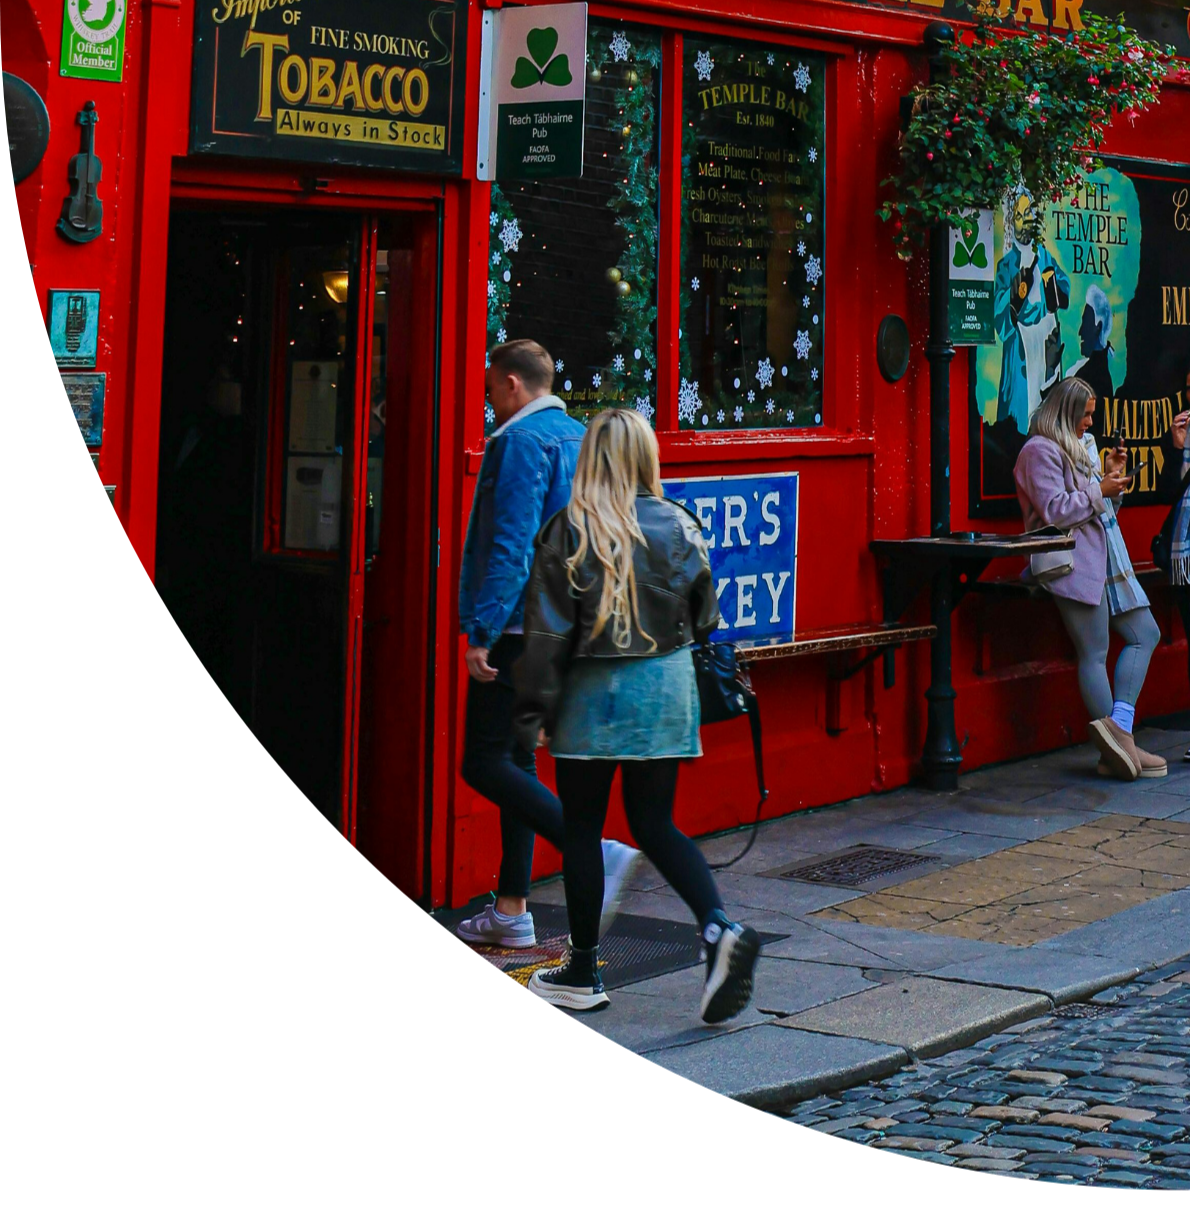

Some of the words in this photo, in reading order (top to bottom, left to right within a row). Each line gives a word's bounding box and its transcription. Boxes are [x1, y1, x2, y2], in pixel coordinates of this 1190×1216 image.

[281, 10, 302, 25] OF
[76, 41, 113, 56] Official
[310, 25, 350, 50] FINE
[353, 32, 430, 60] SMOKING
[72, 53, 115, 68] Member
[241, 29, 430, 122] TOBACCO
[698, 83, 772, 111] TEMPLE
[775, 89, 810, 122] BAR
[508, 114, 532, 125] Teach
[533, 112, 573, 124] Tábhairne
[736, 111, 753, 126] Est.
[755, 113, 775, 127] 1840
[279, 113, 352, 140] Always
[361, 120, 380, 141] in
[388, 120, 443, 146] Stock
[532, 127, 548, 138] Pub
[522, 154, 556, 163] APPROVED
[708, 141, 756, 160] Traditional
[758, 145, 781, 163] Food
[698, 162, 721, 178] Meat
[1052, 211, 1129, 246] TEMPLE
[705, 231, 740, 247] Toasted
[702, 254, 720, 269] Hot
[1072, 243, 1112, 279] BAR
[952, 288, 966, 298] Teach
[966, 300, 976, 310] Pub
[961, 322, 981, 330] APPROVED
[1102, 392, 1173, 440] MALTED
